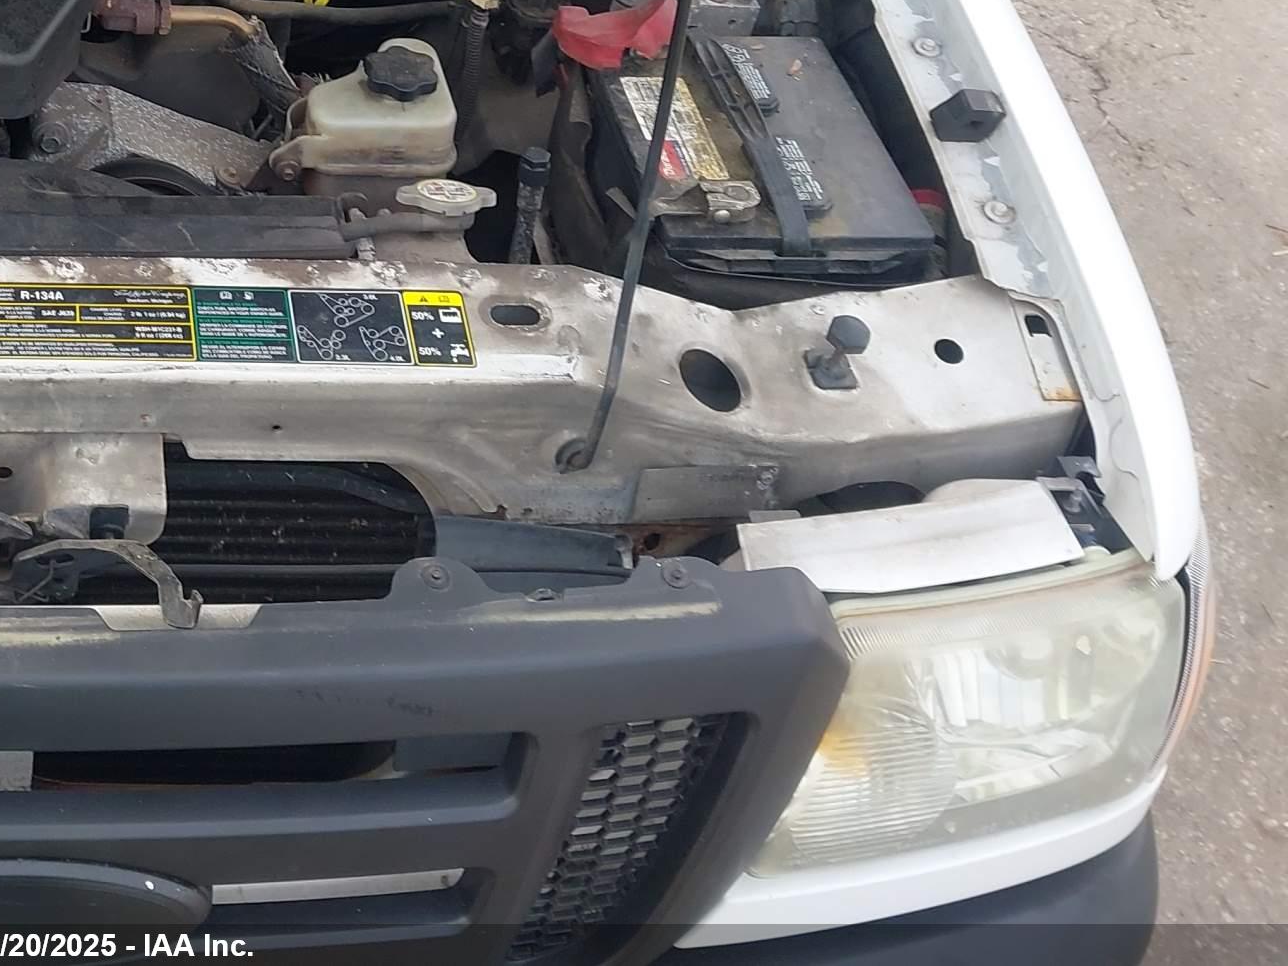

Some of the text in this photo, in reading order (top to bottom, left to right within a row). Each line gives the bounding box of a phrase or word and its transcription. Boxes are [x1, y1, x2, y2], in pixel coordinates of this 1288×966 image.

[20, 290, 65, 301] R-134A
[411, 311, 435, 321] 50%
[418, 346, 442, 356] 50%
